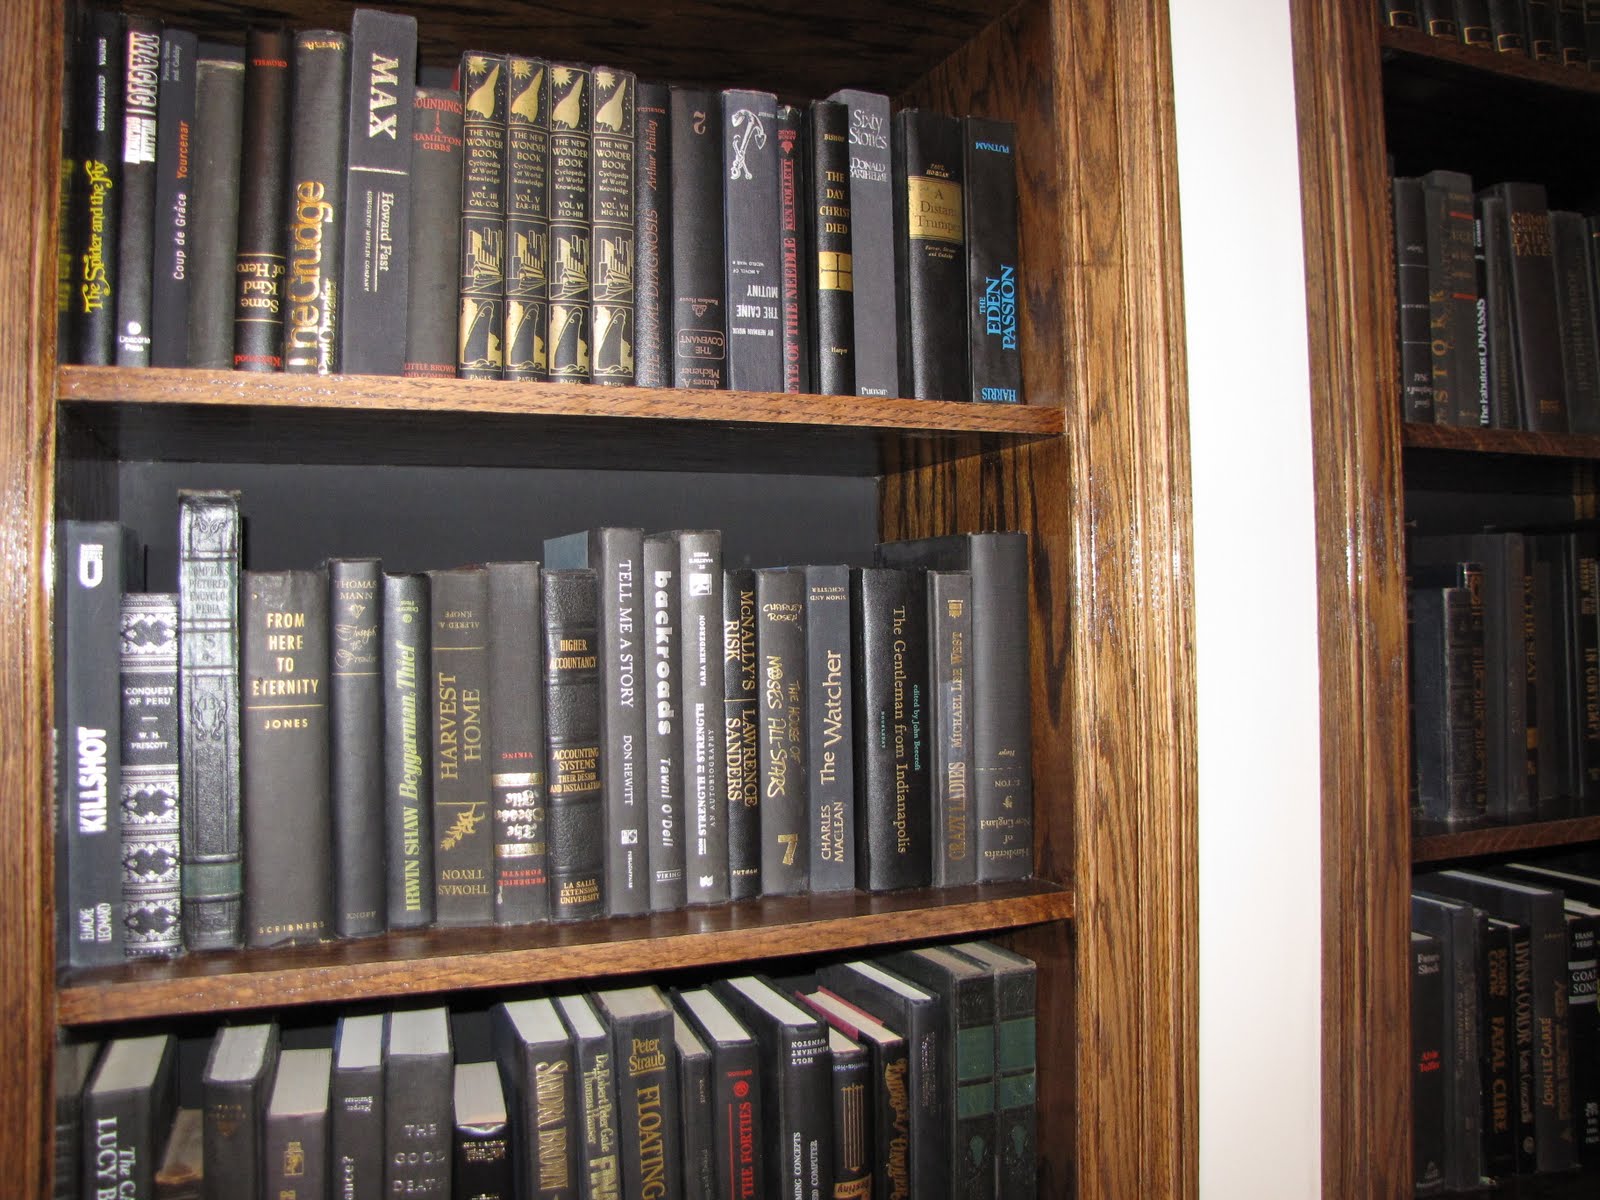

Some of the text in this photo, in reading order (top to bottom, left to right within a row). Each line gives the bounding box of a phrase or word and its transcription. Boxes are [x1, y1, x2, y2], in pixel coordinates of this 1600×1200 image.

[367, 52, 399, 140] MAX
[693, 112, 706, 135] 2
[486, 130, 501, 138] NEW
[175, 120, 189, 180] Yourcenar
[466, 138, 503, 149] WONDER
[570, 140, 586, 148] NEW
[614, 142, 629, 150] NEW
[975, 142, 1009, 154] PUTNAM
[472, 150, 498, 159] BOOK
[552, 148, 588, 158] WONDER
[596, 149, 631, 160] WONDER
[647, 120, 658, 191] Arthur Hailey
[558, 158, 583, 168] BOOK
[602, 160, 626, 170] BOOK
[555, 169, 586, 177] Cyclopedia
[599, 170, 629, 179] Cyclopedia
[826, 172, 845, 182] THE
[826, 188, 845, 200] DAY
[935, 189, 944, 200] A
[558, 201, 575, 209] VOL.
[601, 201, 617, 209] VOL.
[819, 206, 850, 218] CHRIST
[380, 191, 396, 272] Howard Fast
[826, 222, 848, 233] DIED
[172, 192, 188, 281] Coup de Grâce
[286, 181, 334, 303] Grudge
[646, 209, 659, 298] DIAGNOSIS
[83, 234, 110, 296] Spider
[236, 262, 285, 277] of Hero
[243, 280, 278, 296] Kind
[746, 285, 778, 299] MUTINY
[784, 238, 799, 336] THE NEEDLE
[240, 297, 279, 313] Some
[736, 304, 778, 319] THE CAINE
[987, 277, 1001, 335] EDEN
[1000, 264, 1016, 350] PASSION
[680, 335, 724, 346] COVENANT
[695, 346, 712, 355] THE
[1476, 298, 1490, 425] The Fabulous ONASSIS
[680, 367, 720, 378] Michener
[982, 387, 1016, 402] HARRIS
[334, 580, 377, 589] THOMAS
[340, 592, 373, 600] MANN
[266, 612, 305, 628] FROM
[767, 613, 798, 621] ROSEN
[619, 560, 634, 708] TELL ME A STORY
[724, 620, 740, 662] RISK
[269, 635, 303, 650] HERE
[654, 570, 675, 735] backroads
[276, 657, 294, 672] TO
[125, 687, 175, 696] CONQUEST
[252, 679, 319, 696] ETERNITY
[129, 696, 171, 706] OF PERU
[264, 718, 308, 730] JONES
[439, 672, 458, 779] HARVEST
[462, 689, 481, 761] HOME
[820, 650, 843, 785] The Watcher
[951, 694, 963, 748] MICHAEL
[893, 605, 910, 853] The Gentleman from Indianapolis
[912, 720, 921, 738] John
[131, 741, 168, 750] PRESCOTT
[558, 759, 596, 771] SYSTEMS
[726, 718, 742, 801] SANDERS
[742, 709, 758, 807] LAWRENCE
[623, 735, 633, 806] DON HEWITT
[696, 703, 707, 836] STRENGTH STRENGTH
[78, 726, 108, 834] KILLSHOT
[708, 729, 716, 828] AN AUTOBIOGRAPHY
[660, 758, 674, 847] Tawni O'Dell
[821, 804, 831, 860] CHARLES
[833, 801, 844, 863] MACLEAN
[778, 833, 798, 866] 7
[404, 806, 421, 911] IRWIN SHAW
[442, 869, 484, 880] TRYON
[656, 871, 682, 879] VIKING
[439, 884, 489, 895] THOMAS
[576, 879, 596, 887] SALLE
[258, 920, 325, 934] SCRIBNERS
[632, 1038, 660, 1054] Peter
[791, 1039, 826, 1048] WINSTON
[791, 1046, 828, 1056] RINEHART
[629, 1051, 666, 1072] Straub
[791, 1058, 813, 1066] HOLT
[1542, 1059, 1553, 1072] LE
[1490, 1016, 1508, 1133] FATAL CURE
[535, 1060, 569, 1129] SANDRA
[583, 1068, 597, 1109] Thomas
[1542, 1075, 1554, 1106] JOHN
[597, 1069, 614, 1152] Robert Peter Gale
[404, 1123, 437, 1136] THE
[739, 1102, 753, 1164] FORTIES
[637, 1084, 666, 1200] FLOATING
[96, 1116, 118, 1186] LUCY
[394, 1152, 446, 1164] GOOD
[539, 1127, 569, 1191] BROWN
[793, 1132, 801, 1175] CONCEPTS
[119, 1146, 136, 1176] The
